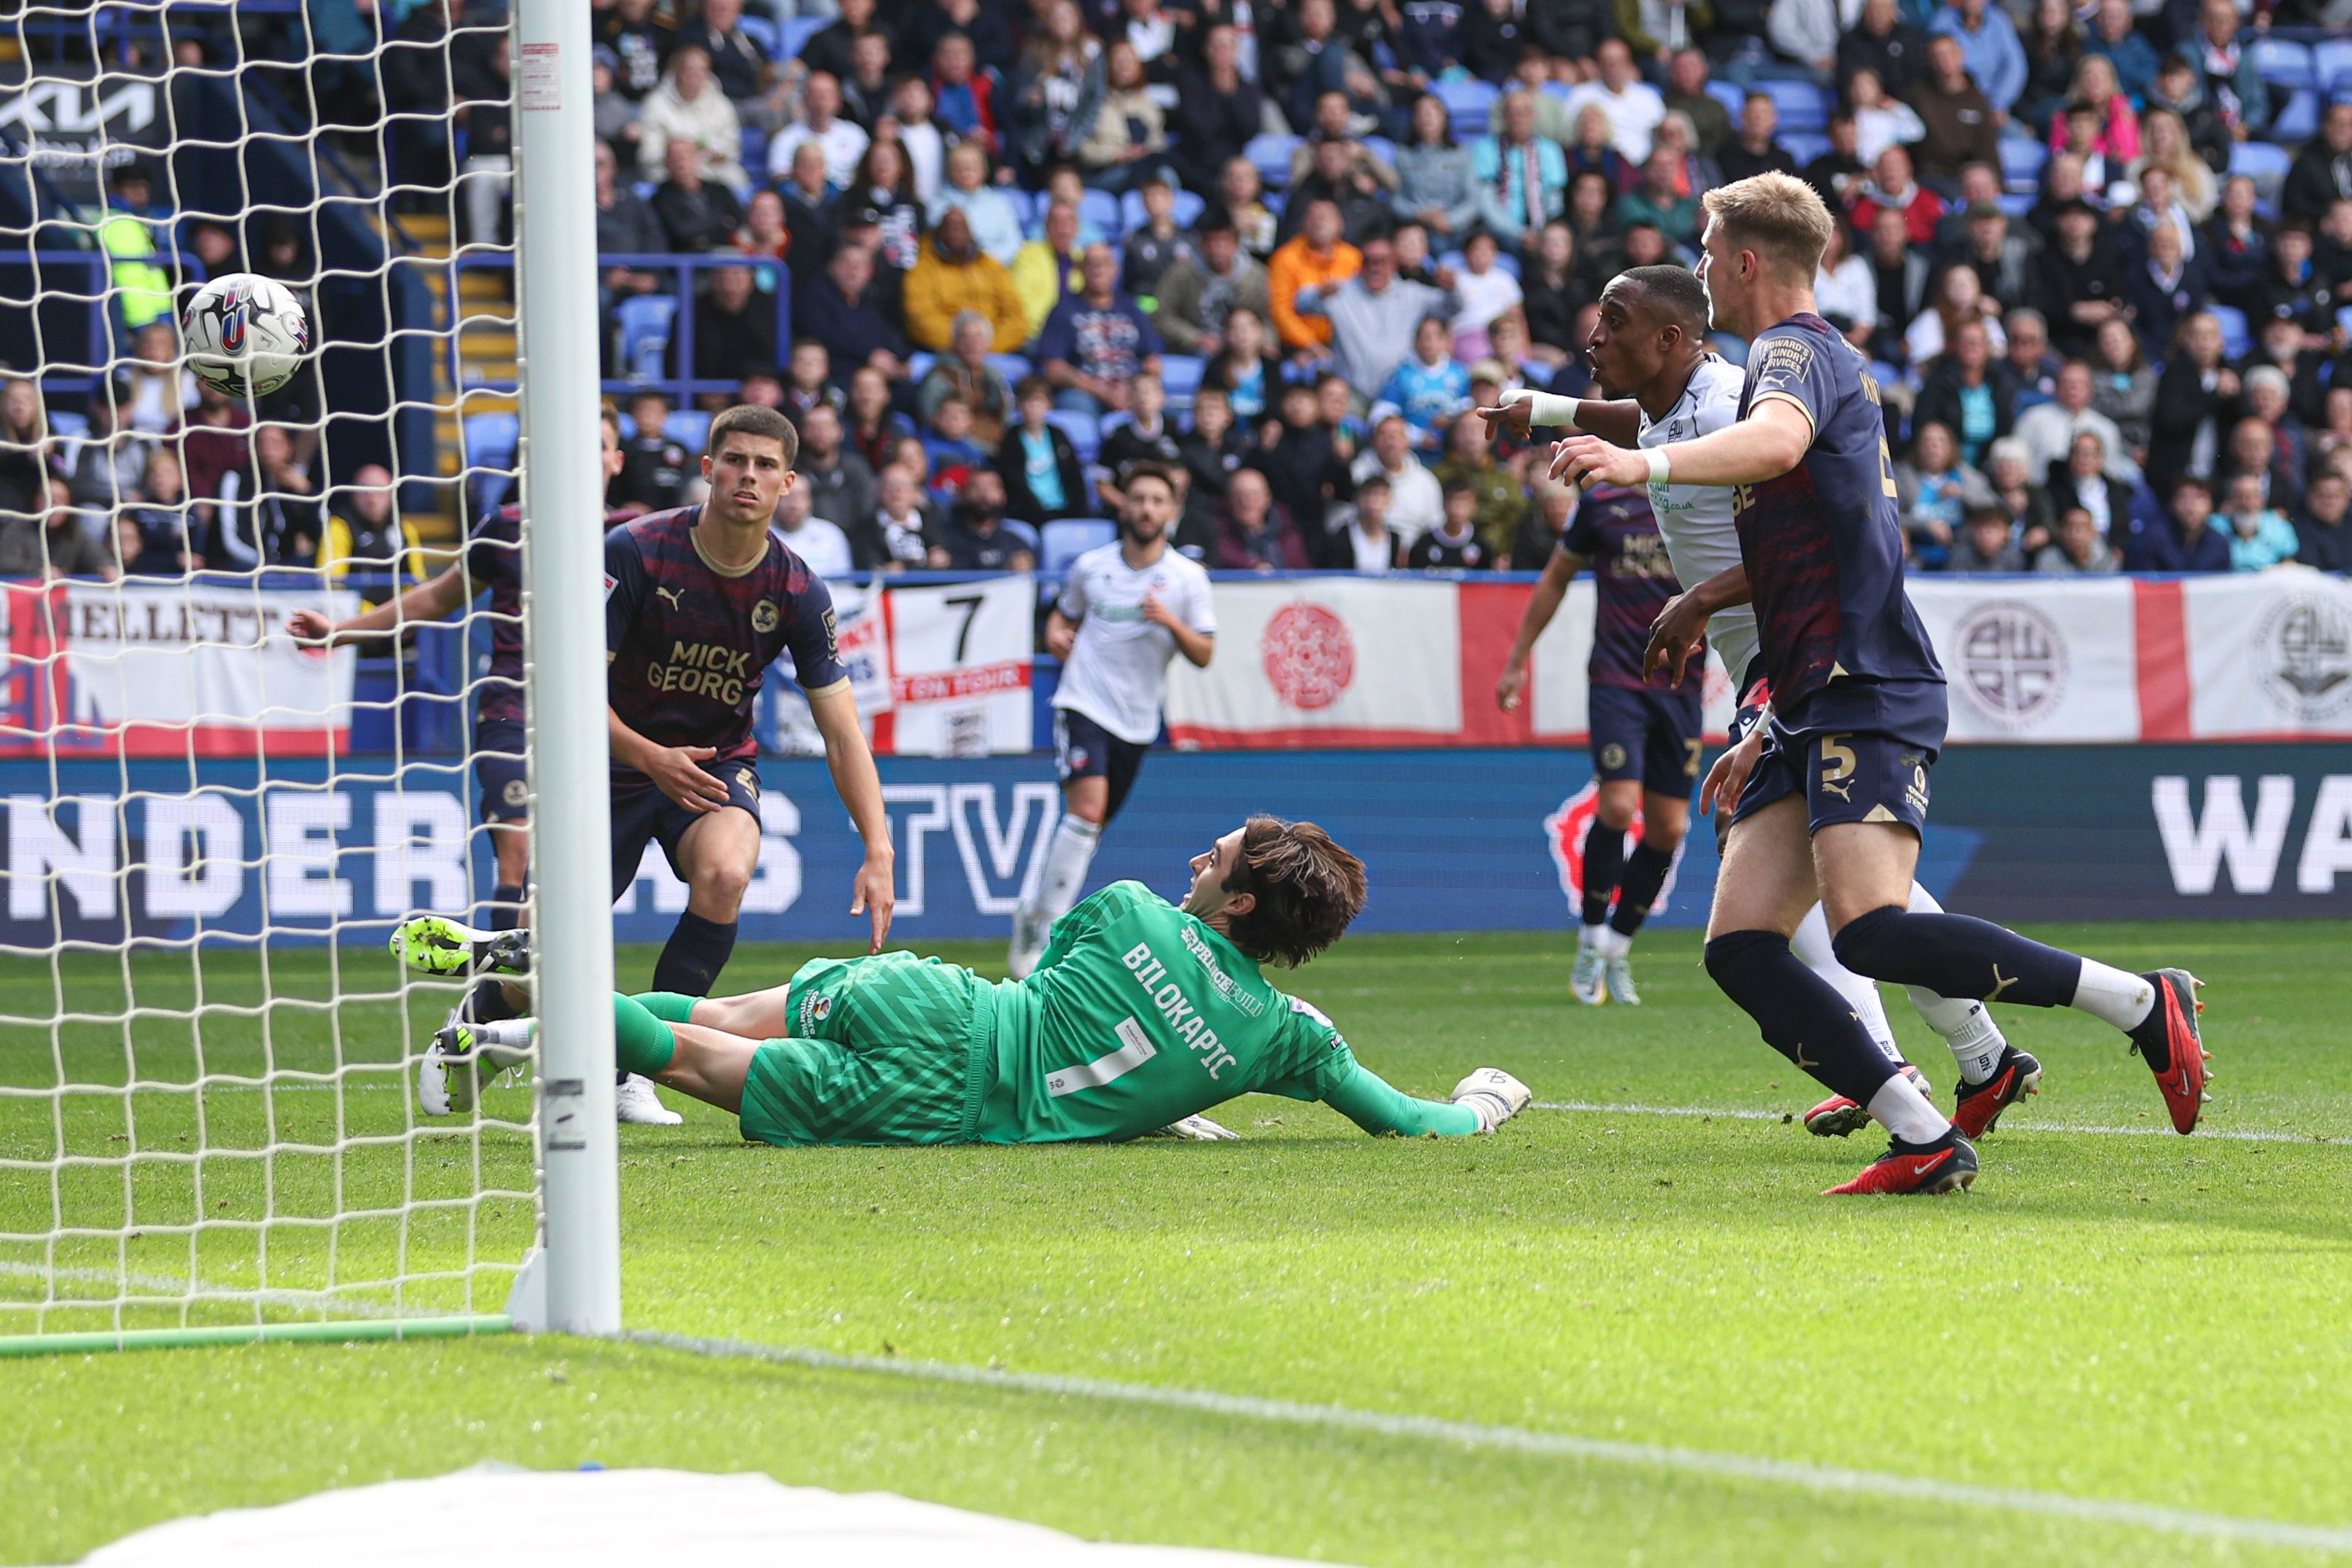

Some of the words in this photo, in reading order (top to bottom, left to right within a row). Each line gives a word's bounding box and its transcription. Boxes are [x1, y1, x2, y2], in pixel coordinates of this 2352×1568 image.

[945, 595, 985, 662] 7
[647, 661, 744, 706] GEORG
[669, 640, 751, 679] MICK
[1821, 732, 1857, 783] 5
[849, 781, 1061, 916] TV
[805, 990, 819, 1035] compare
[1121, 941, 1237, 1081] BILOKAPIC
